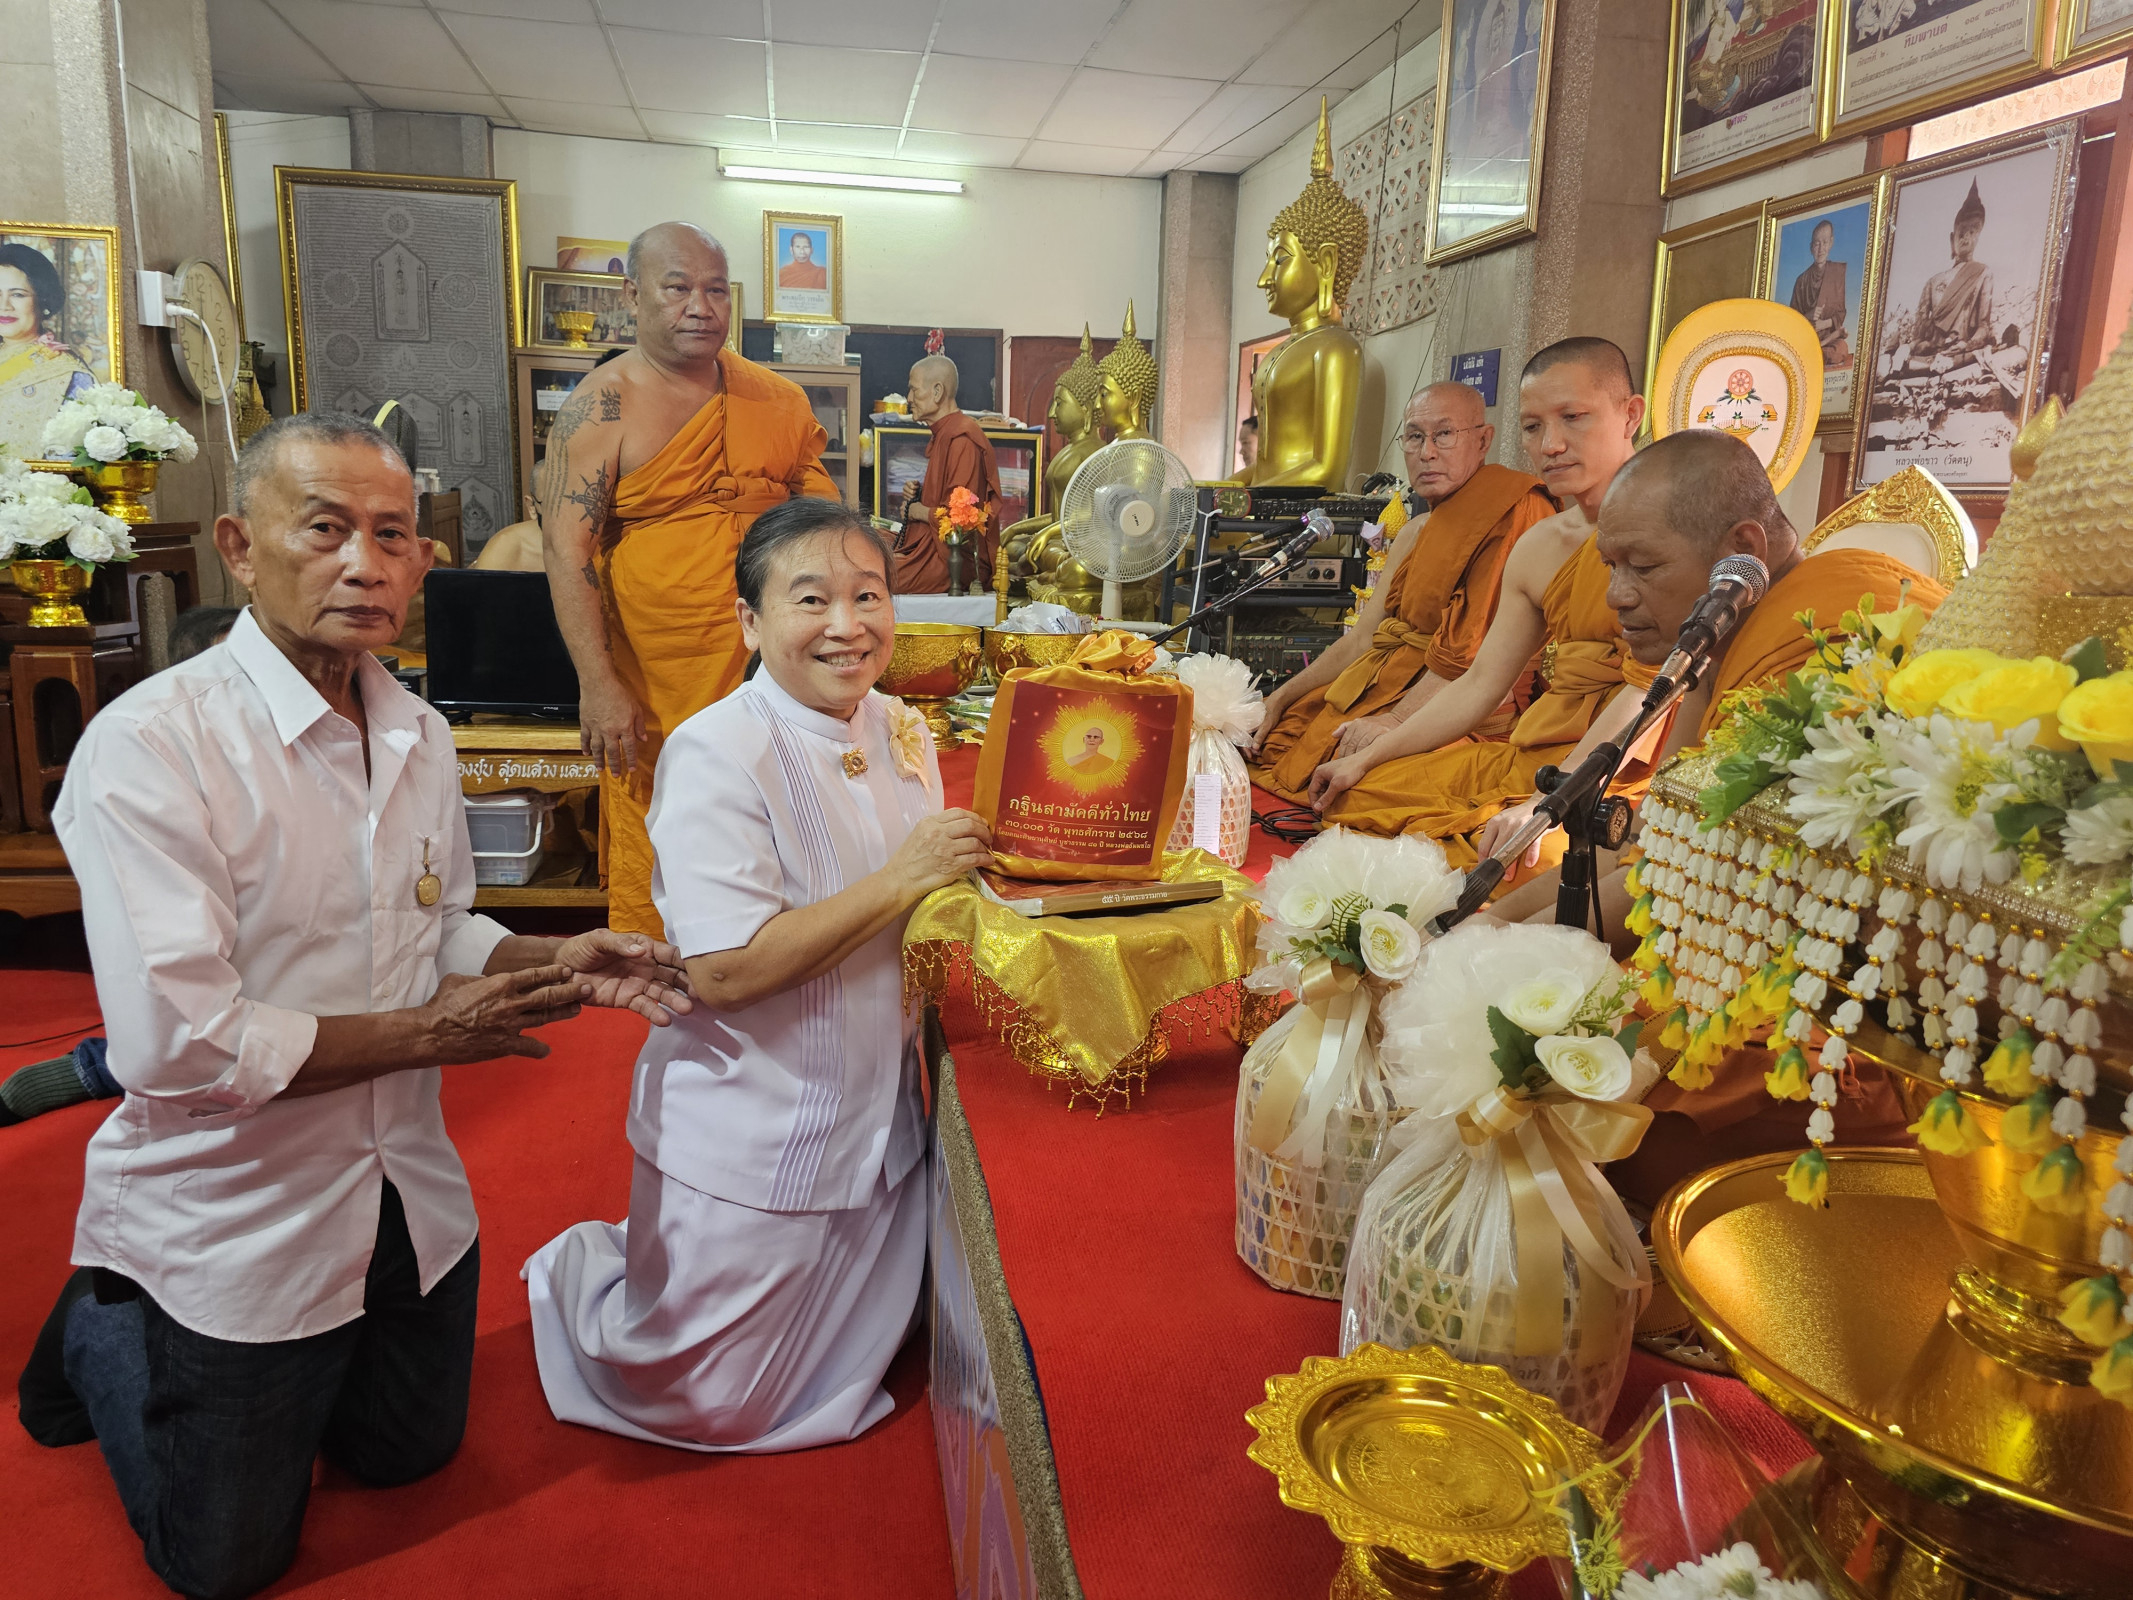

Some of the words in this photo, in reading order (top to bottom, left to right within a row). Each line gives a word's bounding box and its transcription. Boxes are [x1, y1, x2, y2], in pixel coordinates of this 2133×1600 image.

[456, 758, 494, 784] องชุบ
[559, 763, 599, 778] และค
[1009, 795, 1151, 823] กฐินสามัคคีทั่วไทย
[1048, 824, 1060, 834] วัด
[1064, 827, 1116, 838] พุทธศักราช
[1118, 830, 1148, 839] ๒๕๖๘
